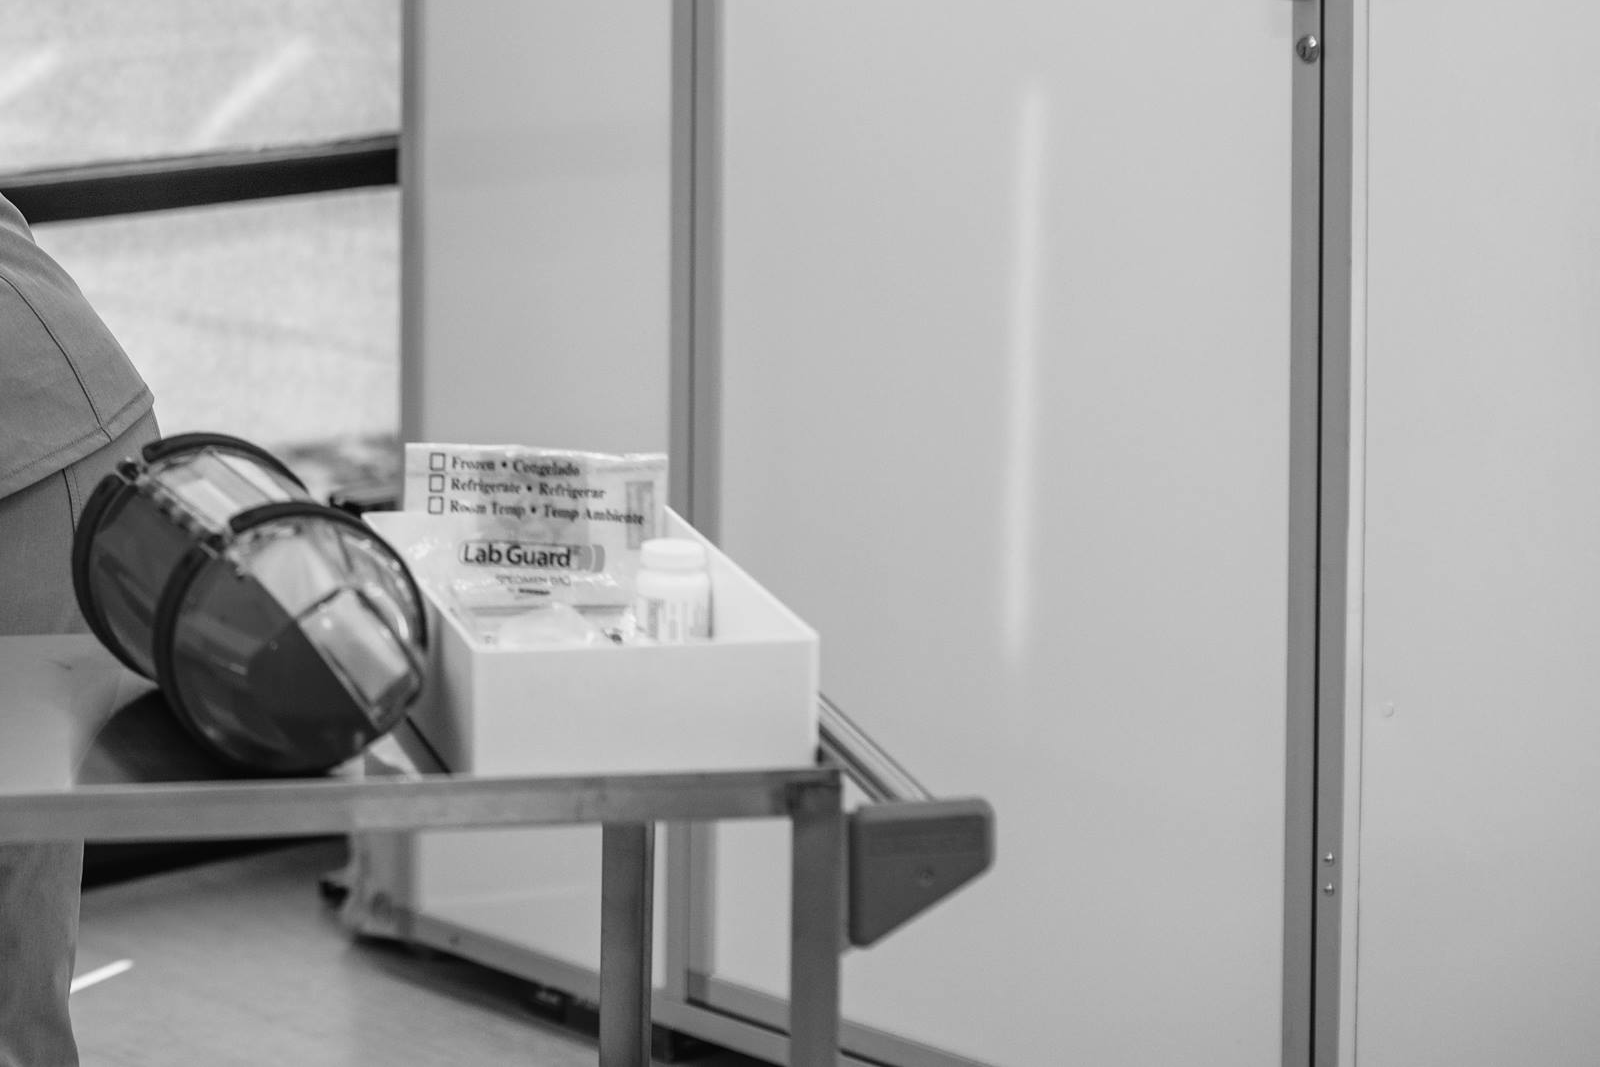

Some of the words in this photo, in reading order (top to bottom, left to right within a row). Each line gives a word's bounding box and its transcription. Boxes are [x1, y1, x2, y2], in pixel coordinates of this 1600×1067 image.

[451, 456, 496, 471] Frozen
[512, 459, 581, 477] Congelado
[450, 477, 522, 495] Refrigerate
[538, 481, 607, 500] Refrigerar
[450, 500, 488, 514] Room
[491, 501, 527, 520] Temp
[544, 504, 581, 522] Temp
[584, 507, 645, 526] Ambiente
[463, 542, 503, 564] Lab
